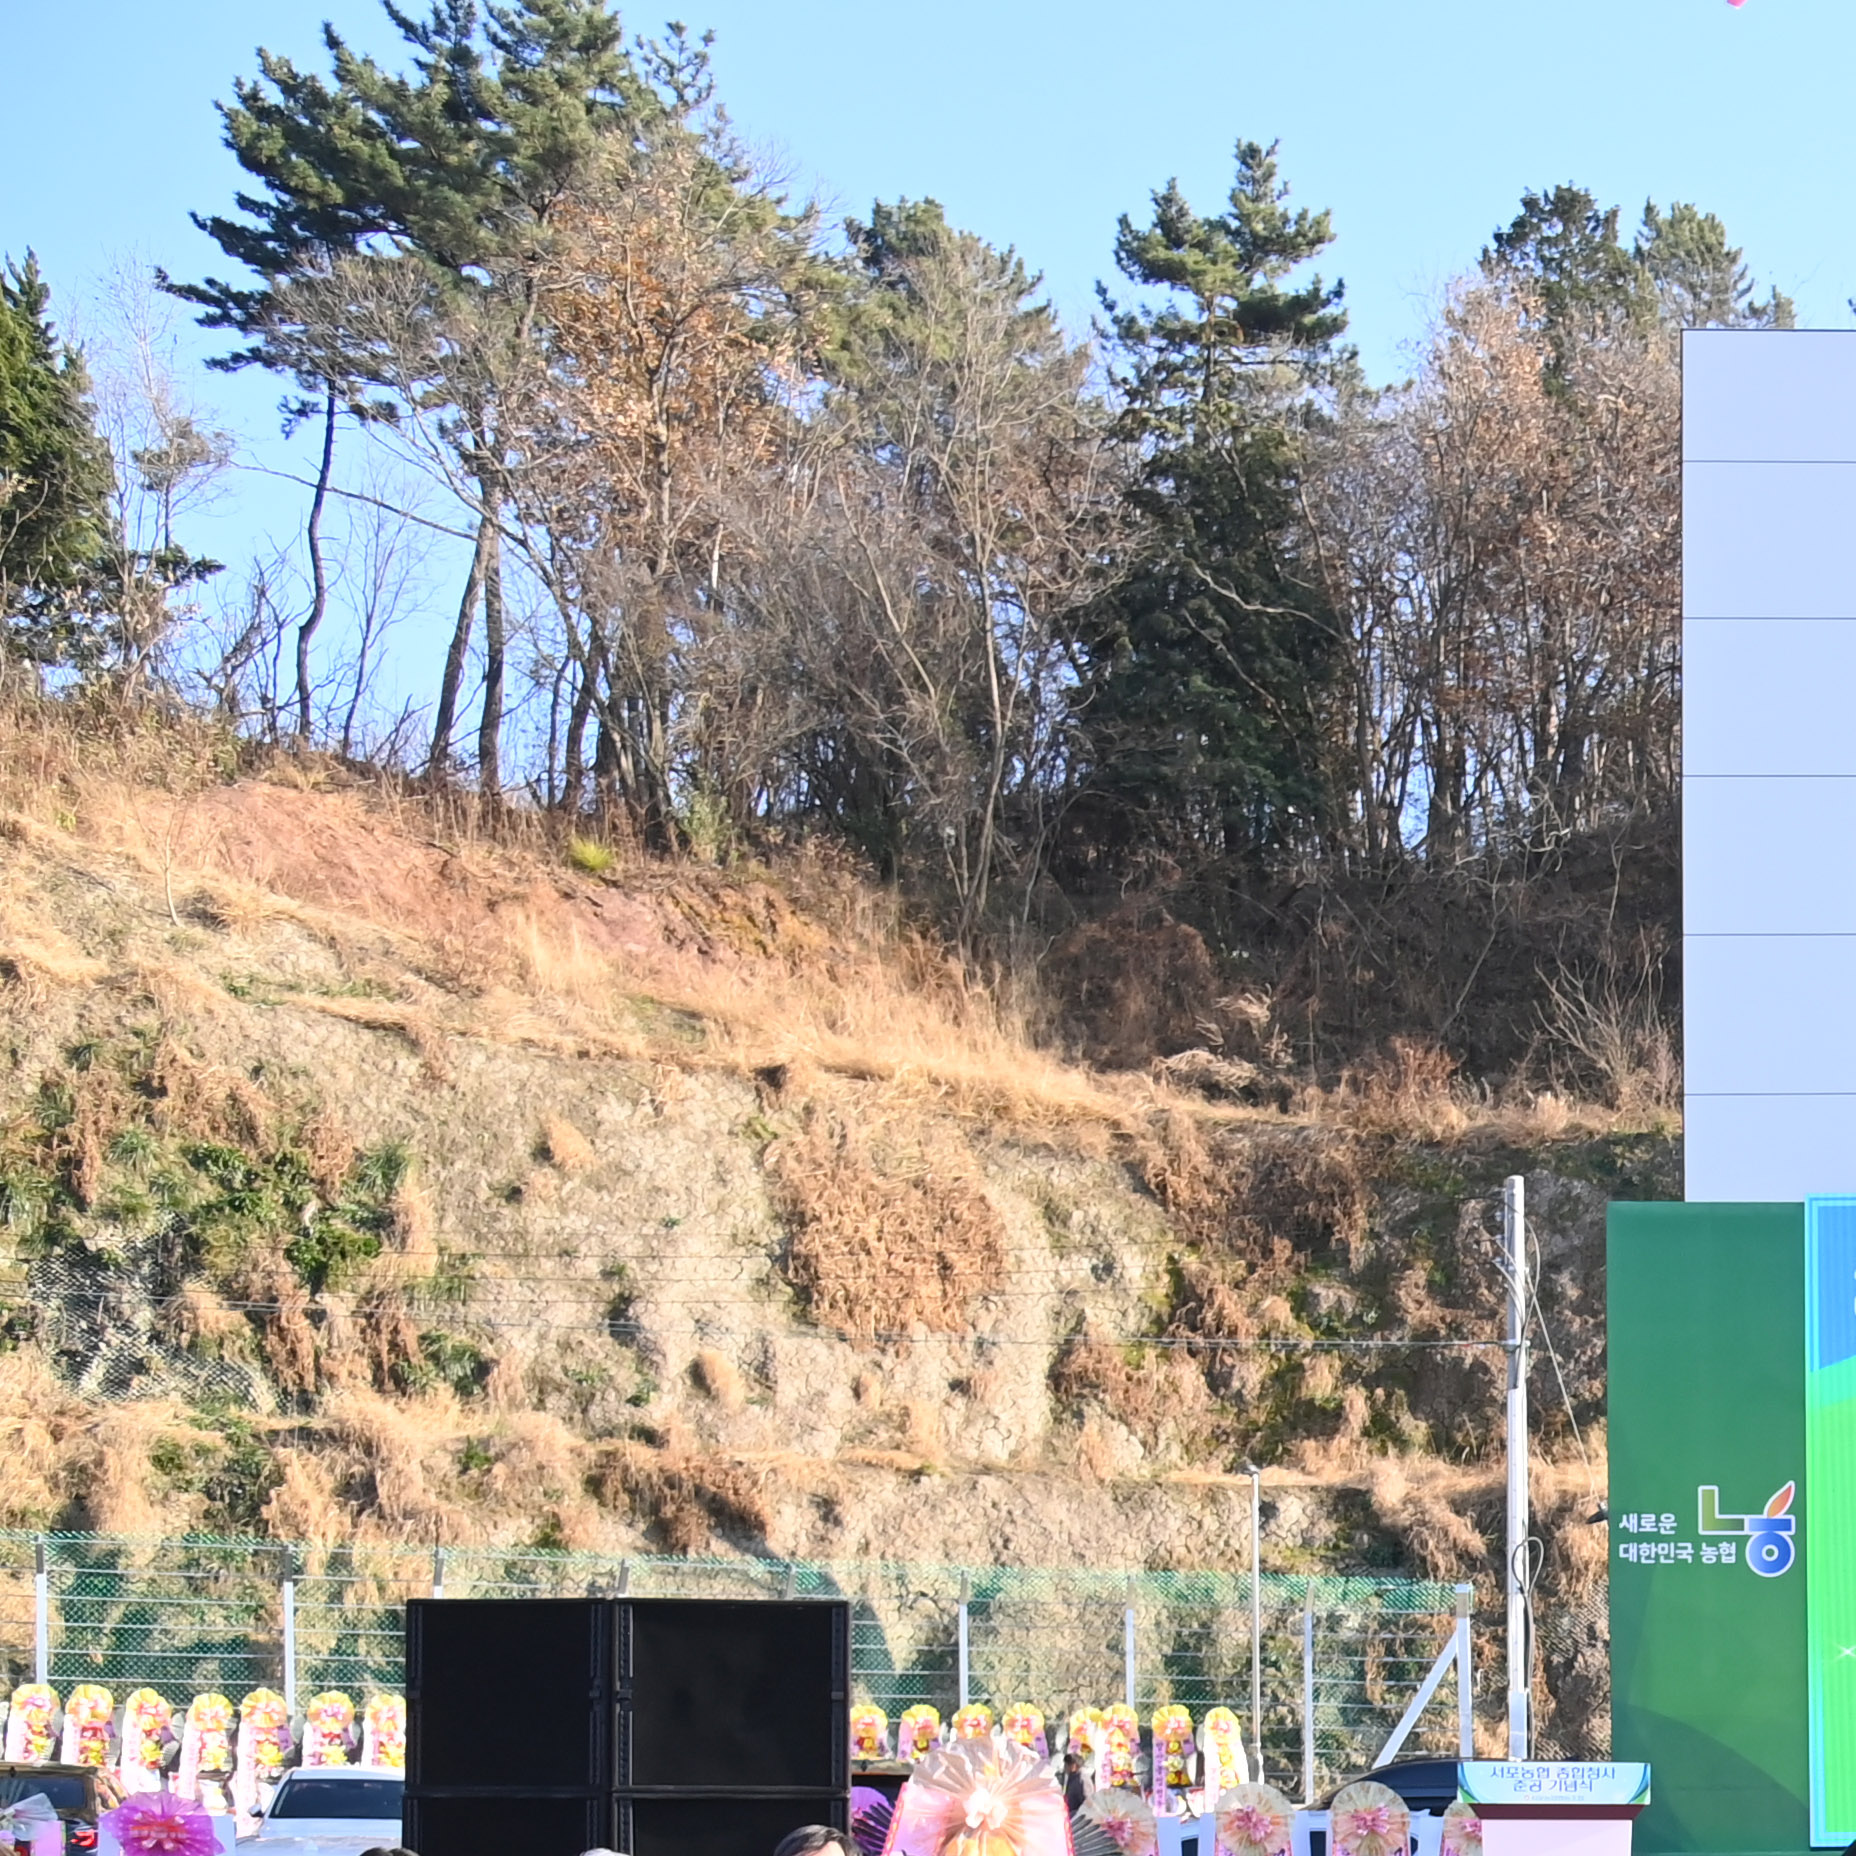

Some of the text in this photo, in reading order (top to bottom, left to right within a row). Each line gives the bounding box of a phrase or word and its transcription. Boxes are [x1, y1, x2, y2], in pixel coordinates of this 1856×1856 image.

[1618, 1512, 1678, 1535] 새로운
[1618, 1541, 1737, 1565] 대한민국 농협
[1548, 1779, 1594, 1793] 기념식
